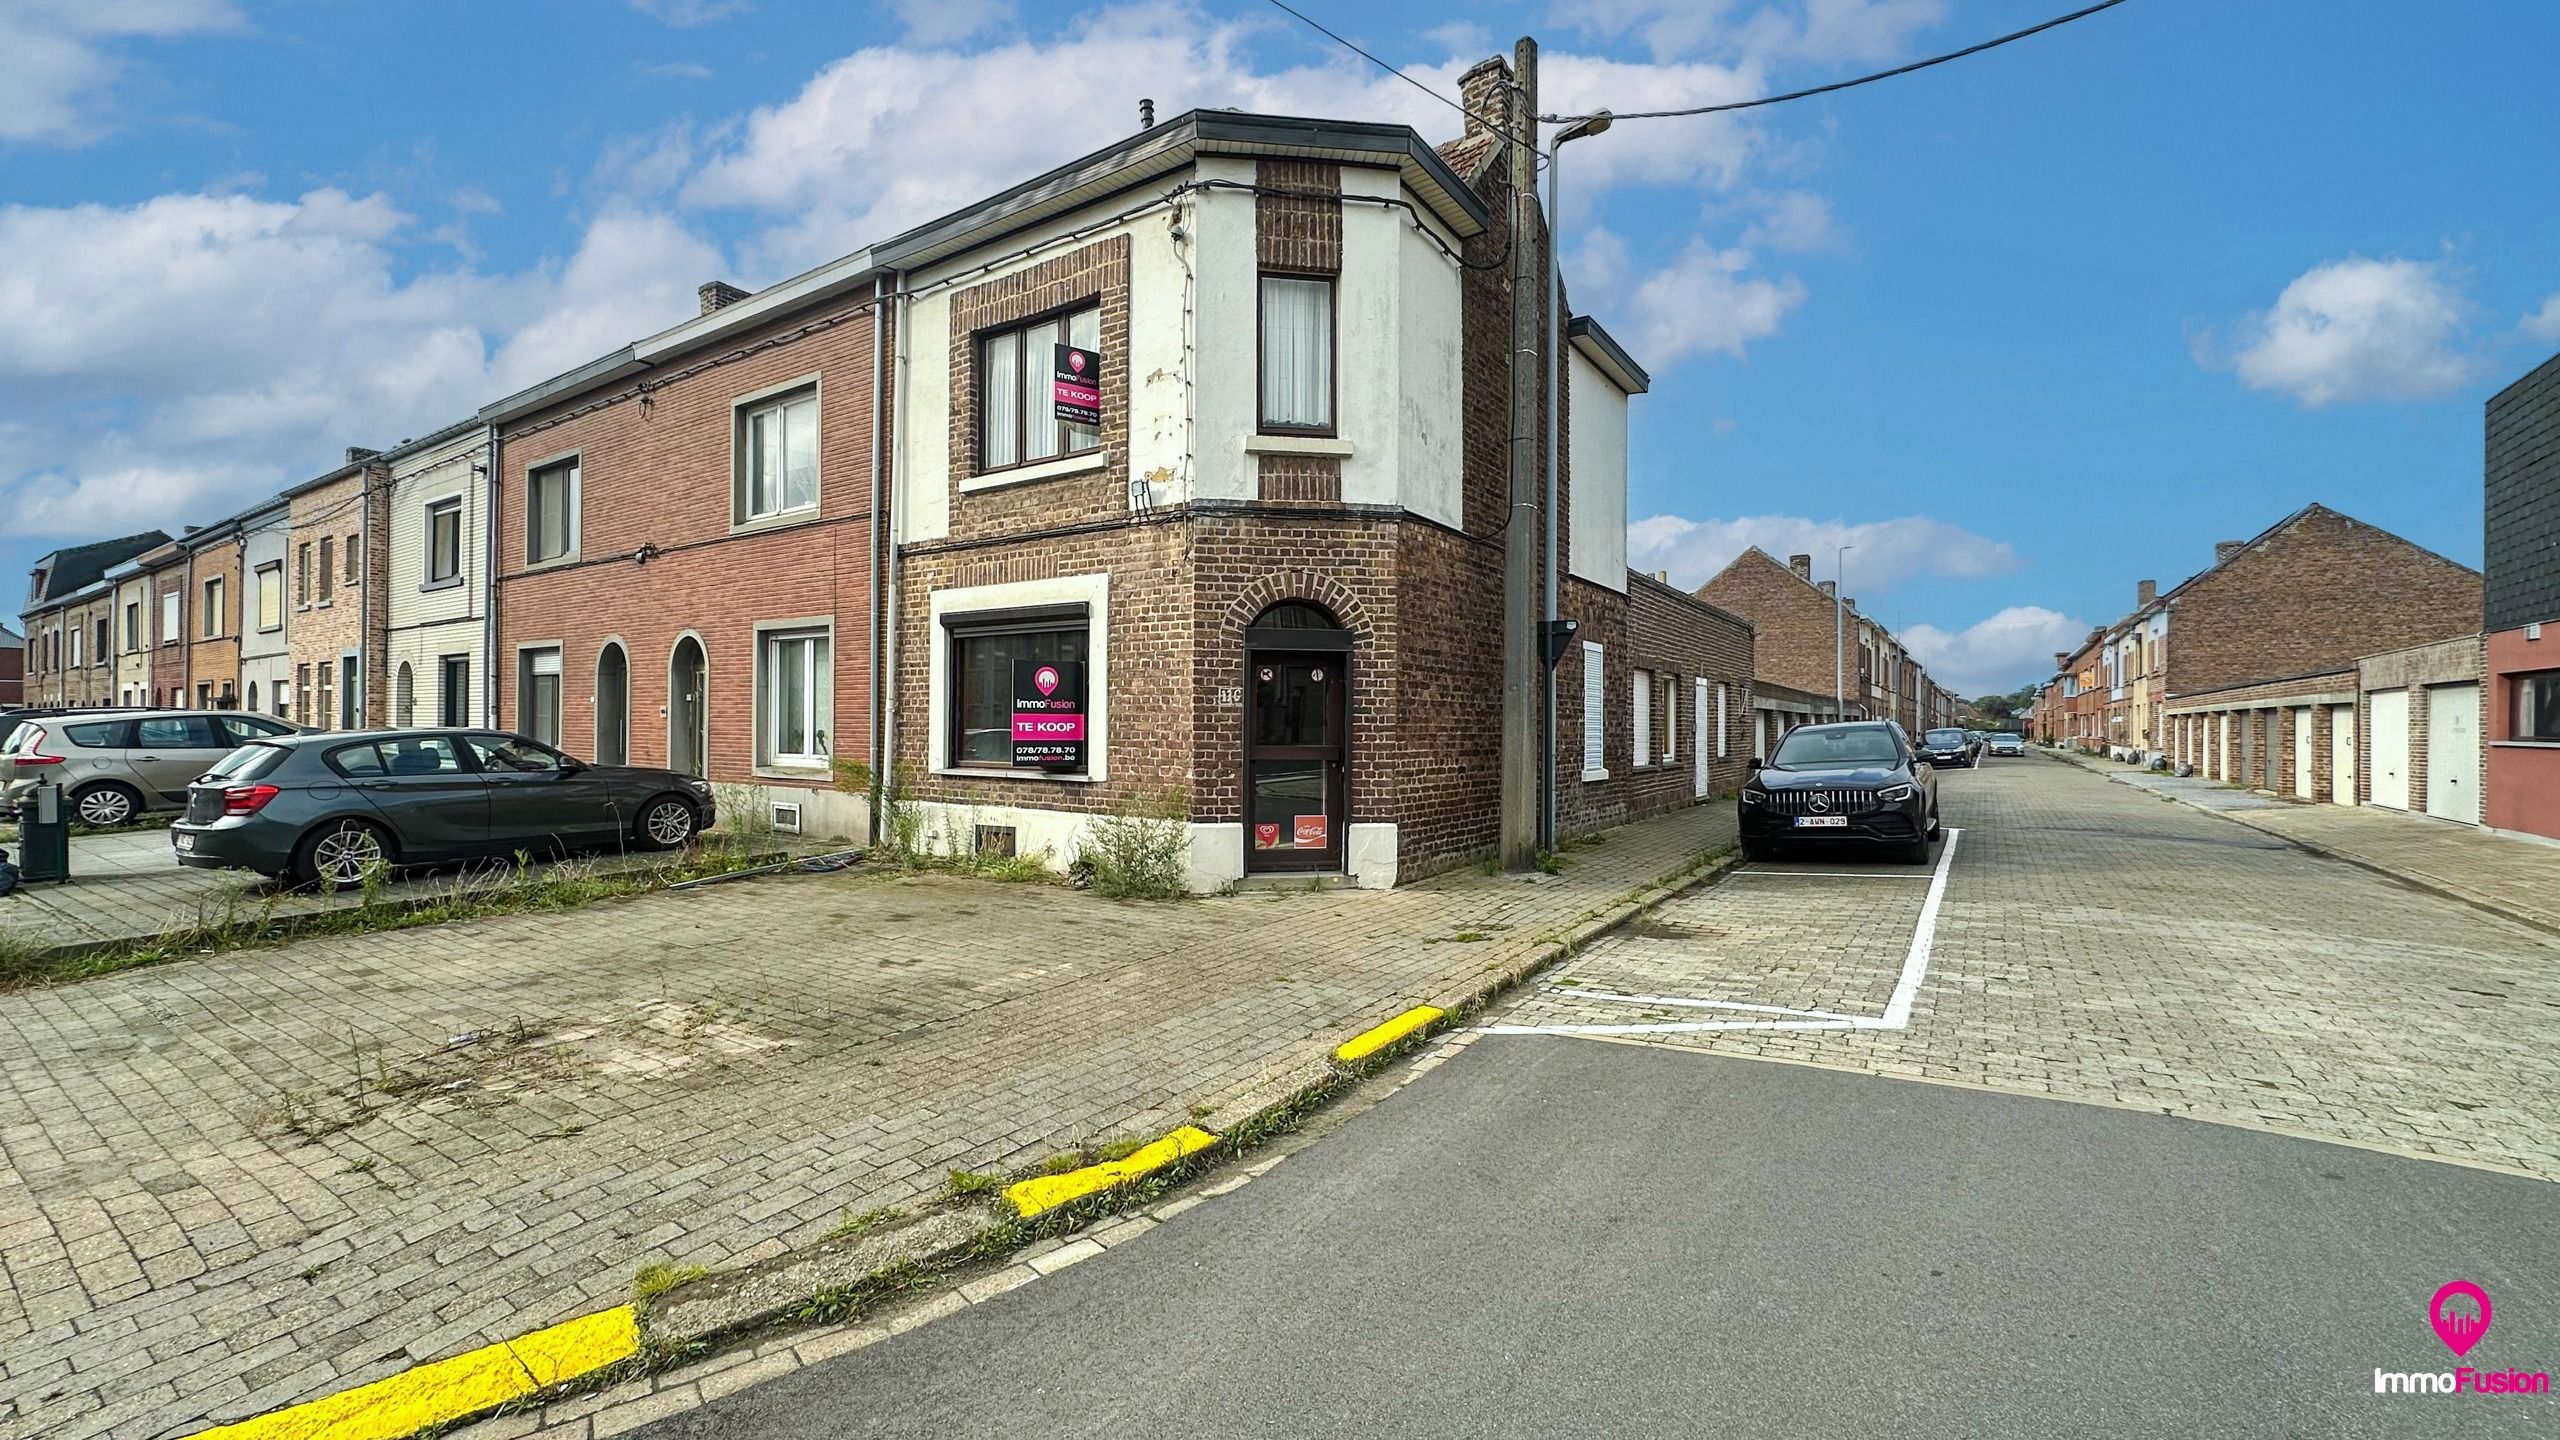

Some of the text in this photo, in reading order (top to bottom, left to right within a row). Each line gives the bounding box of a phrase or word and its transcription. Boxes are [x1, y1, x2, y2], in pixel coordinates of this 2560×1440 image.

[1057, 371, 1097, 385] ImmoFusion
[1057, 388, 1097, 402] TE KOOP
[1017, 699, 1075, 709] ImmoFusion
[1017, 722, 1075, 732] TE KOOP
